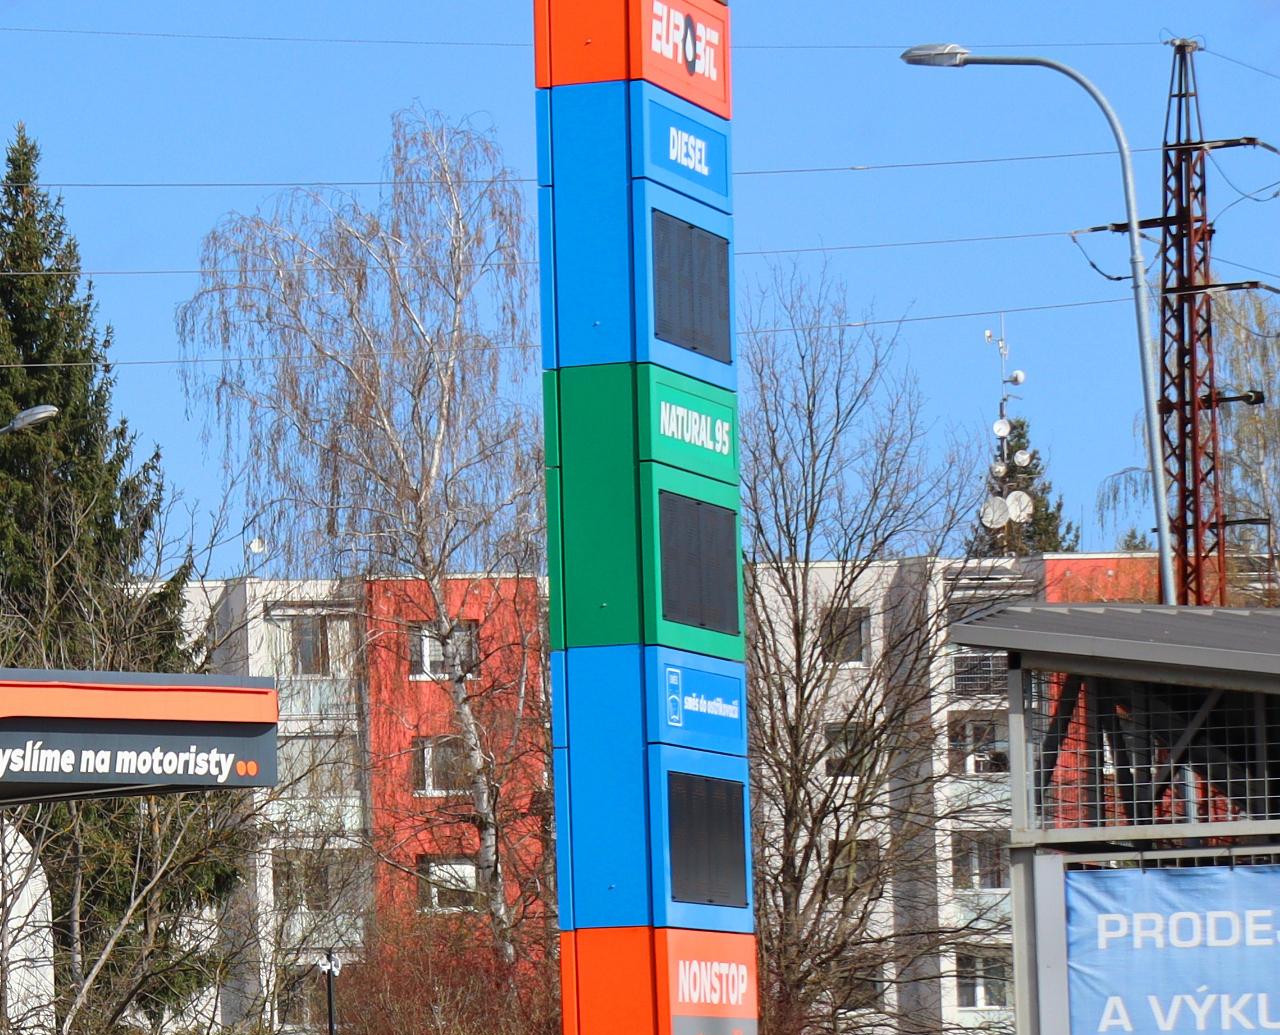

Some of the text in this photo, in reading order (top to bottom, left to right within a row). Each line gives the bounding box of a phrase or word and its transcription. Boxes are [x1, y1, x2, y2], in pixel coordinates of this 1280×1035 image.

[669, 126, 709, 176] DIESEL
[660, 400, 730, 456] NATURAL 95
[79, 749, 111, 774] na
[1096, 909, 1280, 950] PRODE
[678, 960, 748, 1005] NONSTOP
[1096, 995, 1134, 1032] A
